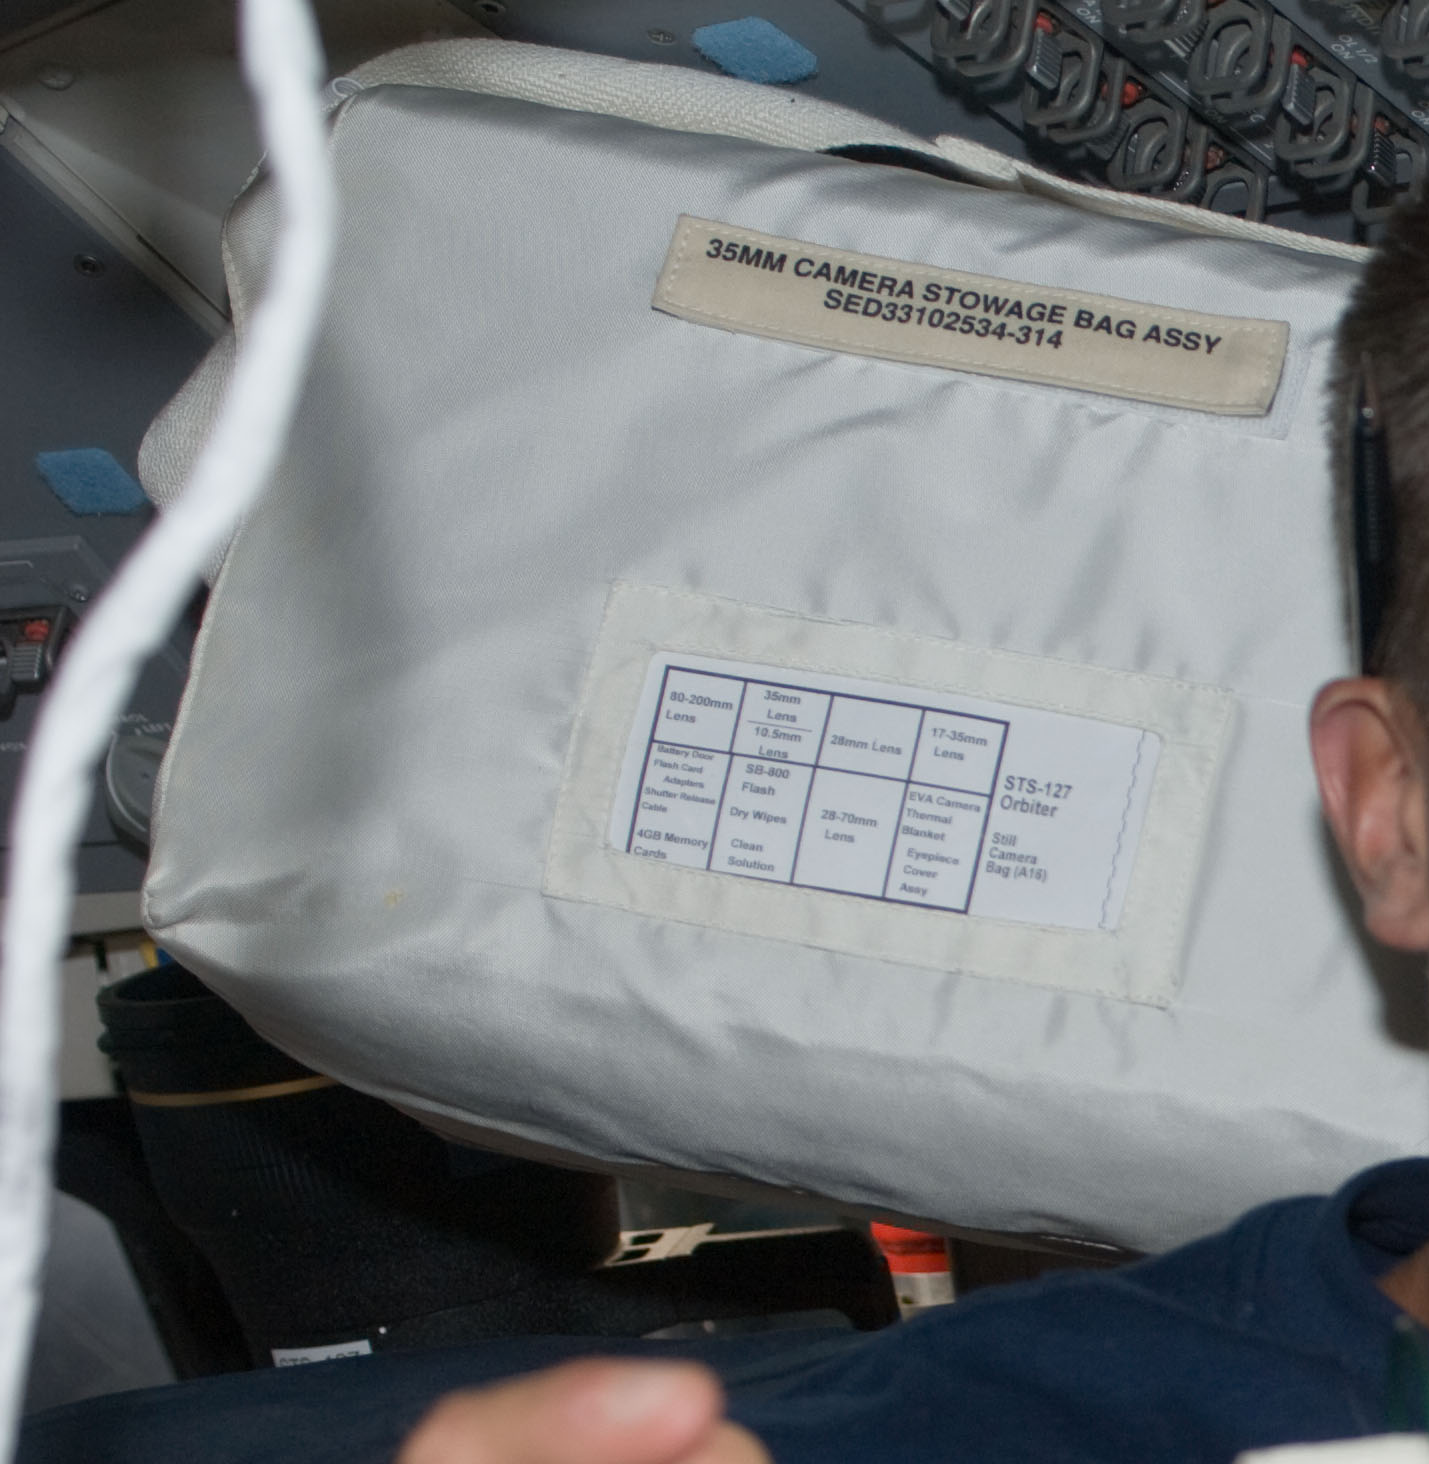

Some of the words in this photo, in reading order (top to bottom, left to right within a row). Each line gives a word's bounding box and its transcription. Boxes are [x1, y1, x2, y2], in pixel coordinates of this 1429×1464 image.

[705, 238, 787, 273] 35MM
[794, 257, 915, 301] CAMERA
[922, 282, 1065, 327] STOWAGE
[1073, 309, 1138, 341] BAG
[1142, 324, 1223, 357] ASSY
[822, 289, 1065, 350] SED33102534-314
[669, 690, 734, 711] 80-200mm
[763, 689, 801, 705] 35mm
[665, 709, 696, 724] Lens
[766, 709, 797, 724] Lens
[754, 726, 802, 743] 10.5mm
[930, 727, 988, 747] 17-35mm
[758, 745, 789, 760] Lens
[829, 734, 868, 751] 28mm
[871, 739, 903, 756] Lens
[933, 746, 965, 762] Lens
[653, 758, 679, 771] Flash
[745, 763, 791, 780] SB-800
[741, 781, 776, 797] Flash
[1003, 775, 1073, 801] STS-127
[908, 790, 934, 805] EVA
[935, 796, 982, 815] Camera
[999, 794, 1059, 819] Orbiter
[729, 806, 749, 821] Dry
[752, 808, 788, 825] Wipes
[820, 808, 878, 828] 28-70mm
[905, 807, 953, 825] Thermal
[636, 828, 662, 842] 4GB
[663, 831, 709, 851] Memory
[823, 828, 856, 844] Lens
[901, 824, 947, 843] Blanket
[991, 831, 1017, 848] Still
[633, 845, 668, 860] Cards
[730, 837, 764, 853] Clean
[727, 855, 775, 873] Solution
[988, 845, 1039, 866] Camera
[902, 864, 938, 880] Cover
[985, 860, 1011, 879] Bag
